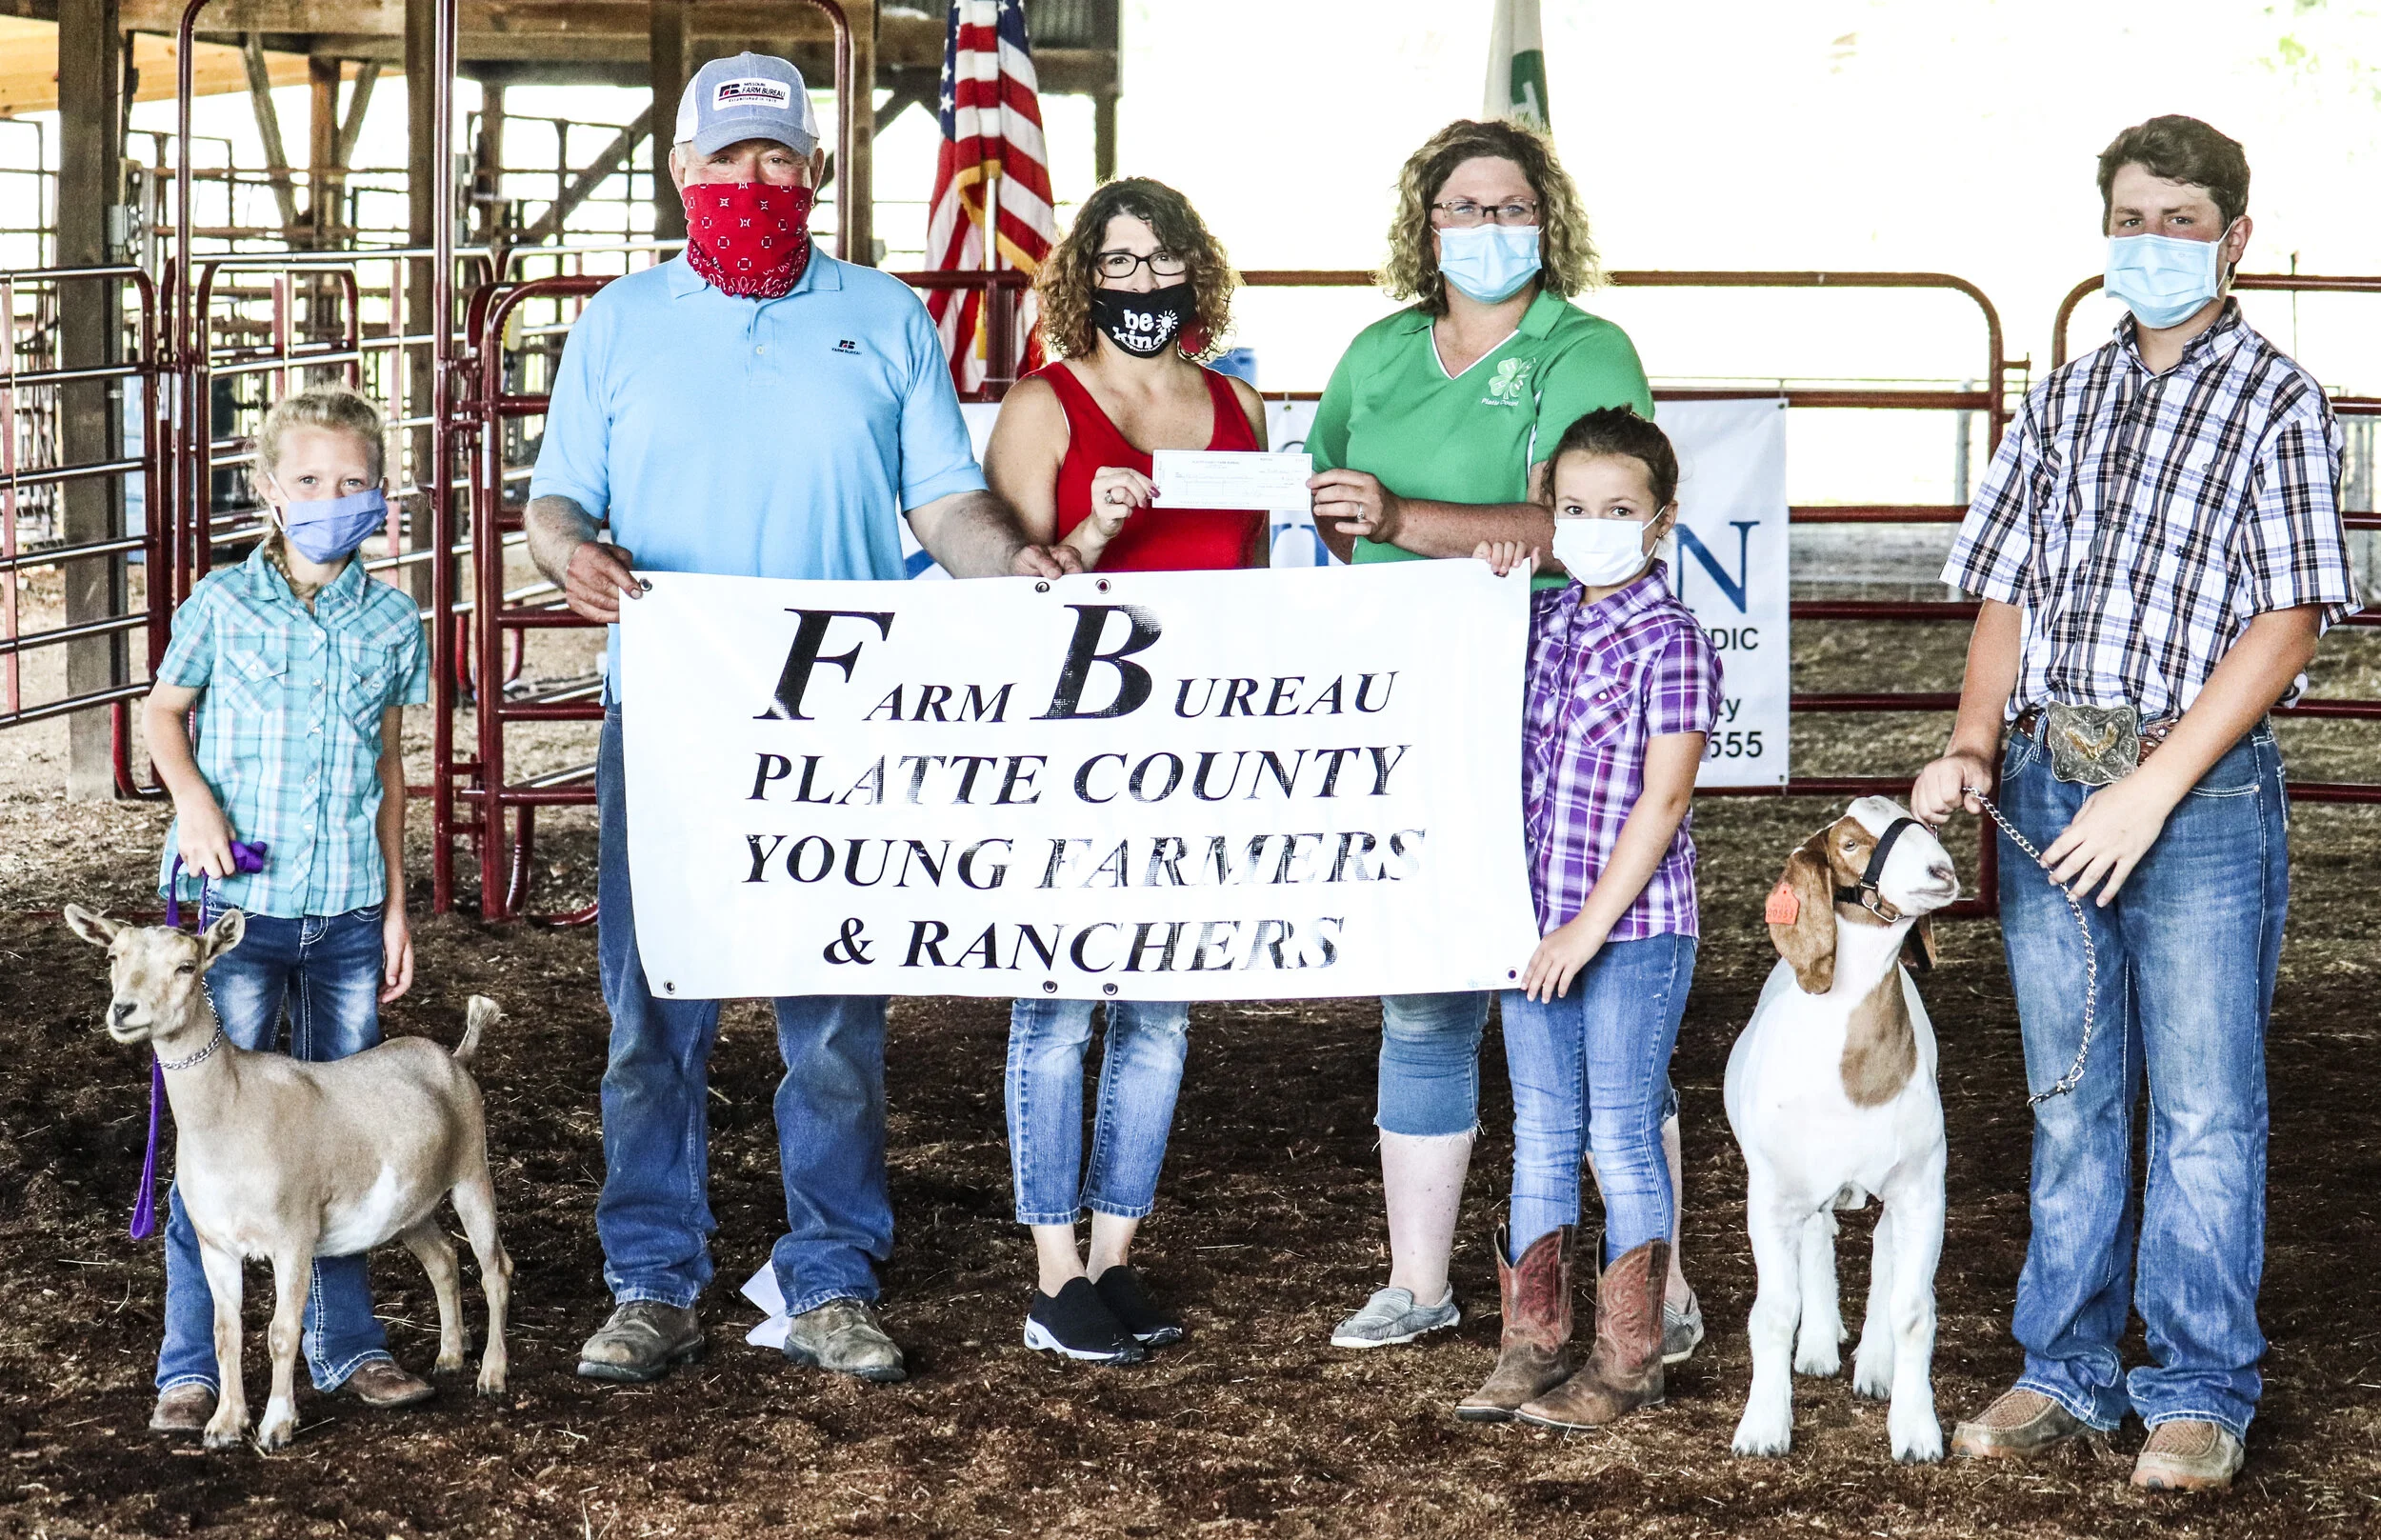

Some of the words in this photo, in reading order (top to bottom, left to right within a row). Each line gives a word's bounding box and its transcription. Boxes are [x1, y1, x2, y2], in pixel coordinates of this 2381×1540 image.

[761, 88, 786, 97] BUREAU
[1123, 310, 1154, 331] be
[1112, 326, 1168, 349] kind
[1704, 627, 1759, 650] DIC
[745, 752, 1048, 806] PLATTE
[1073, 745, 1412, 805] COUNTY
[741, 833, 1015, 890] YOUNG
[1034, 828, 1428, 890] FARMERS
[823, 917, 876, 966] &
[898, 916, 1346, 973] RANCHERS
